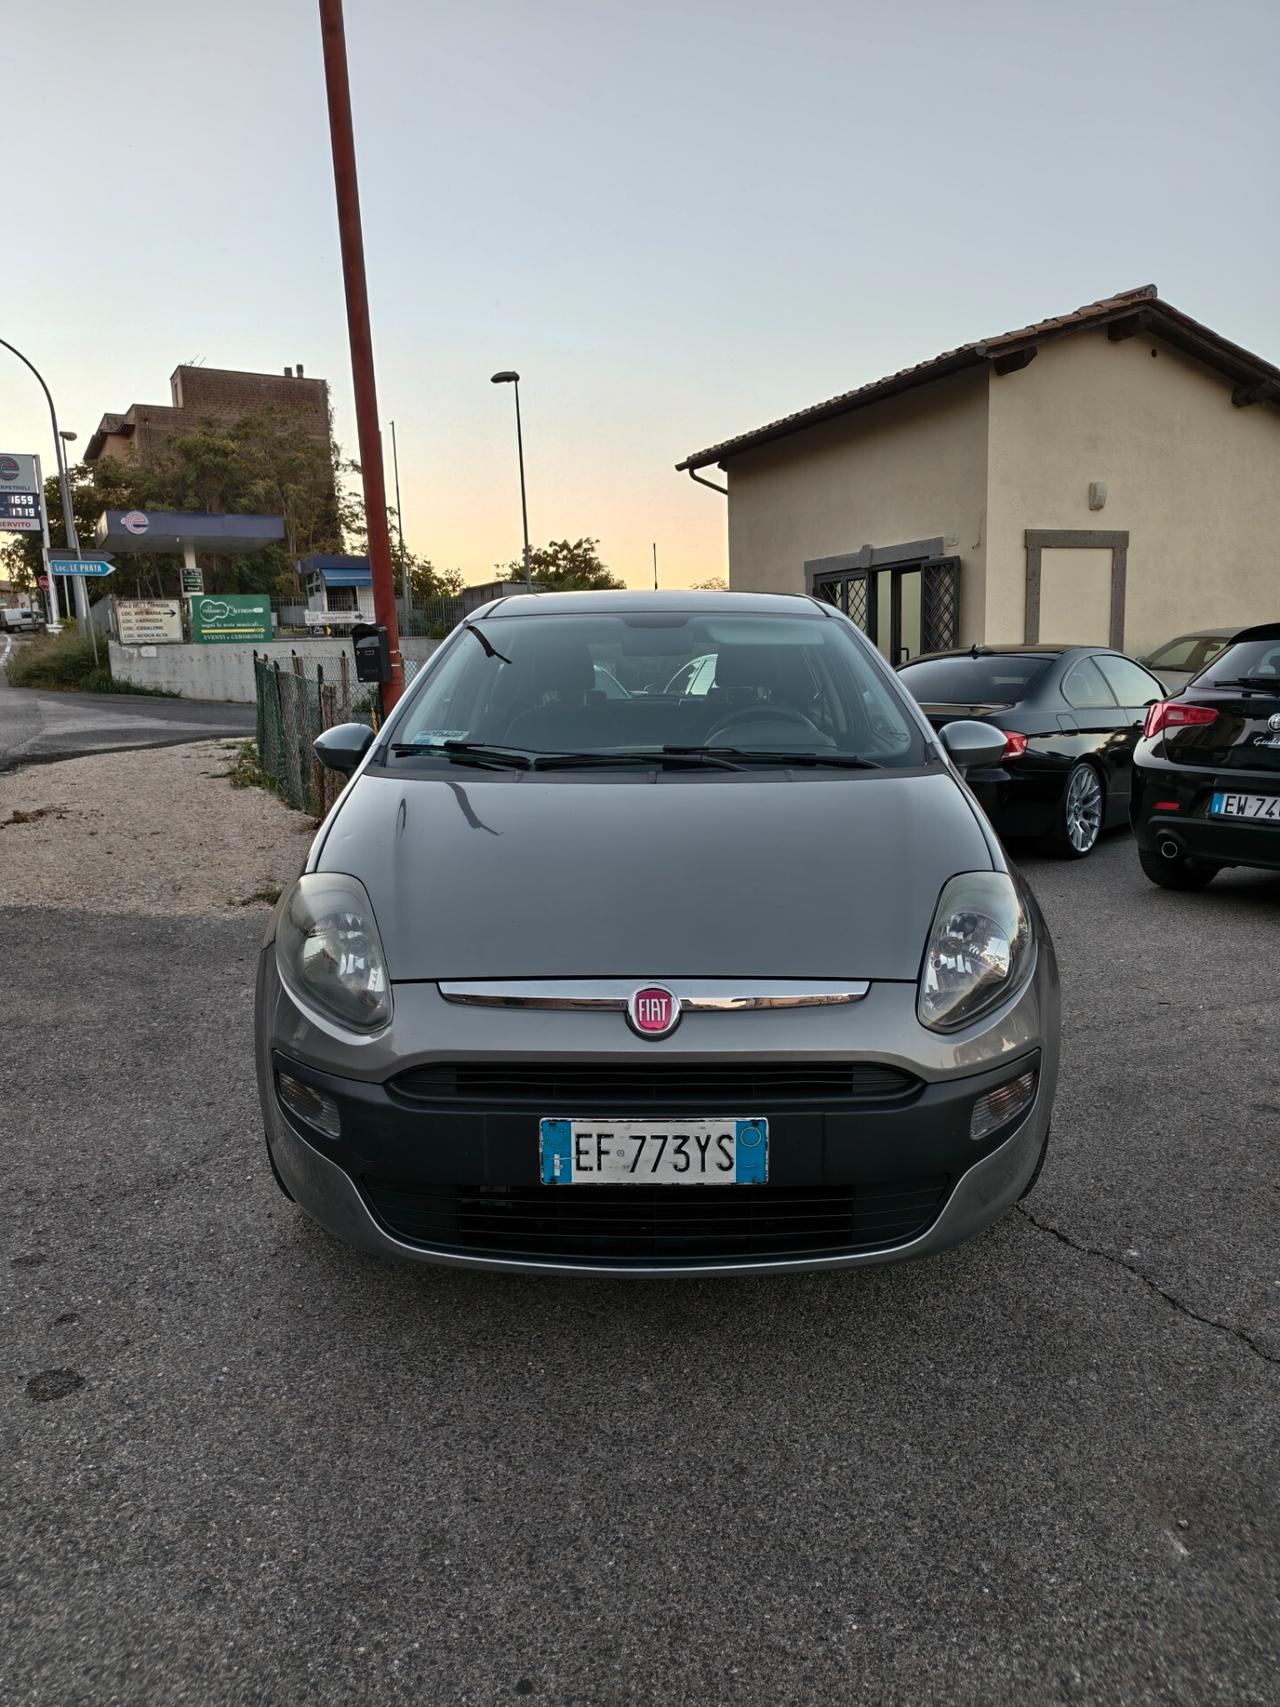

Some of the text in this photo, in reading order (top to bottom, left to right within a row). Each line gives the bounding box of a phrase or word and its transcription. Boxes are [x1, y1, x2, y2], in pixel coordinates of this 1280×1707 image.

[11, 495, 34, 505] 1659
[80, 564, 102, 572] PRATA
[1224, 795, 1280, 818] EW 74
[638, 998, 668, 1022] FIAT
[575, 1133, 735, 1173] EF 773YS
